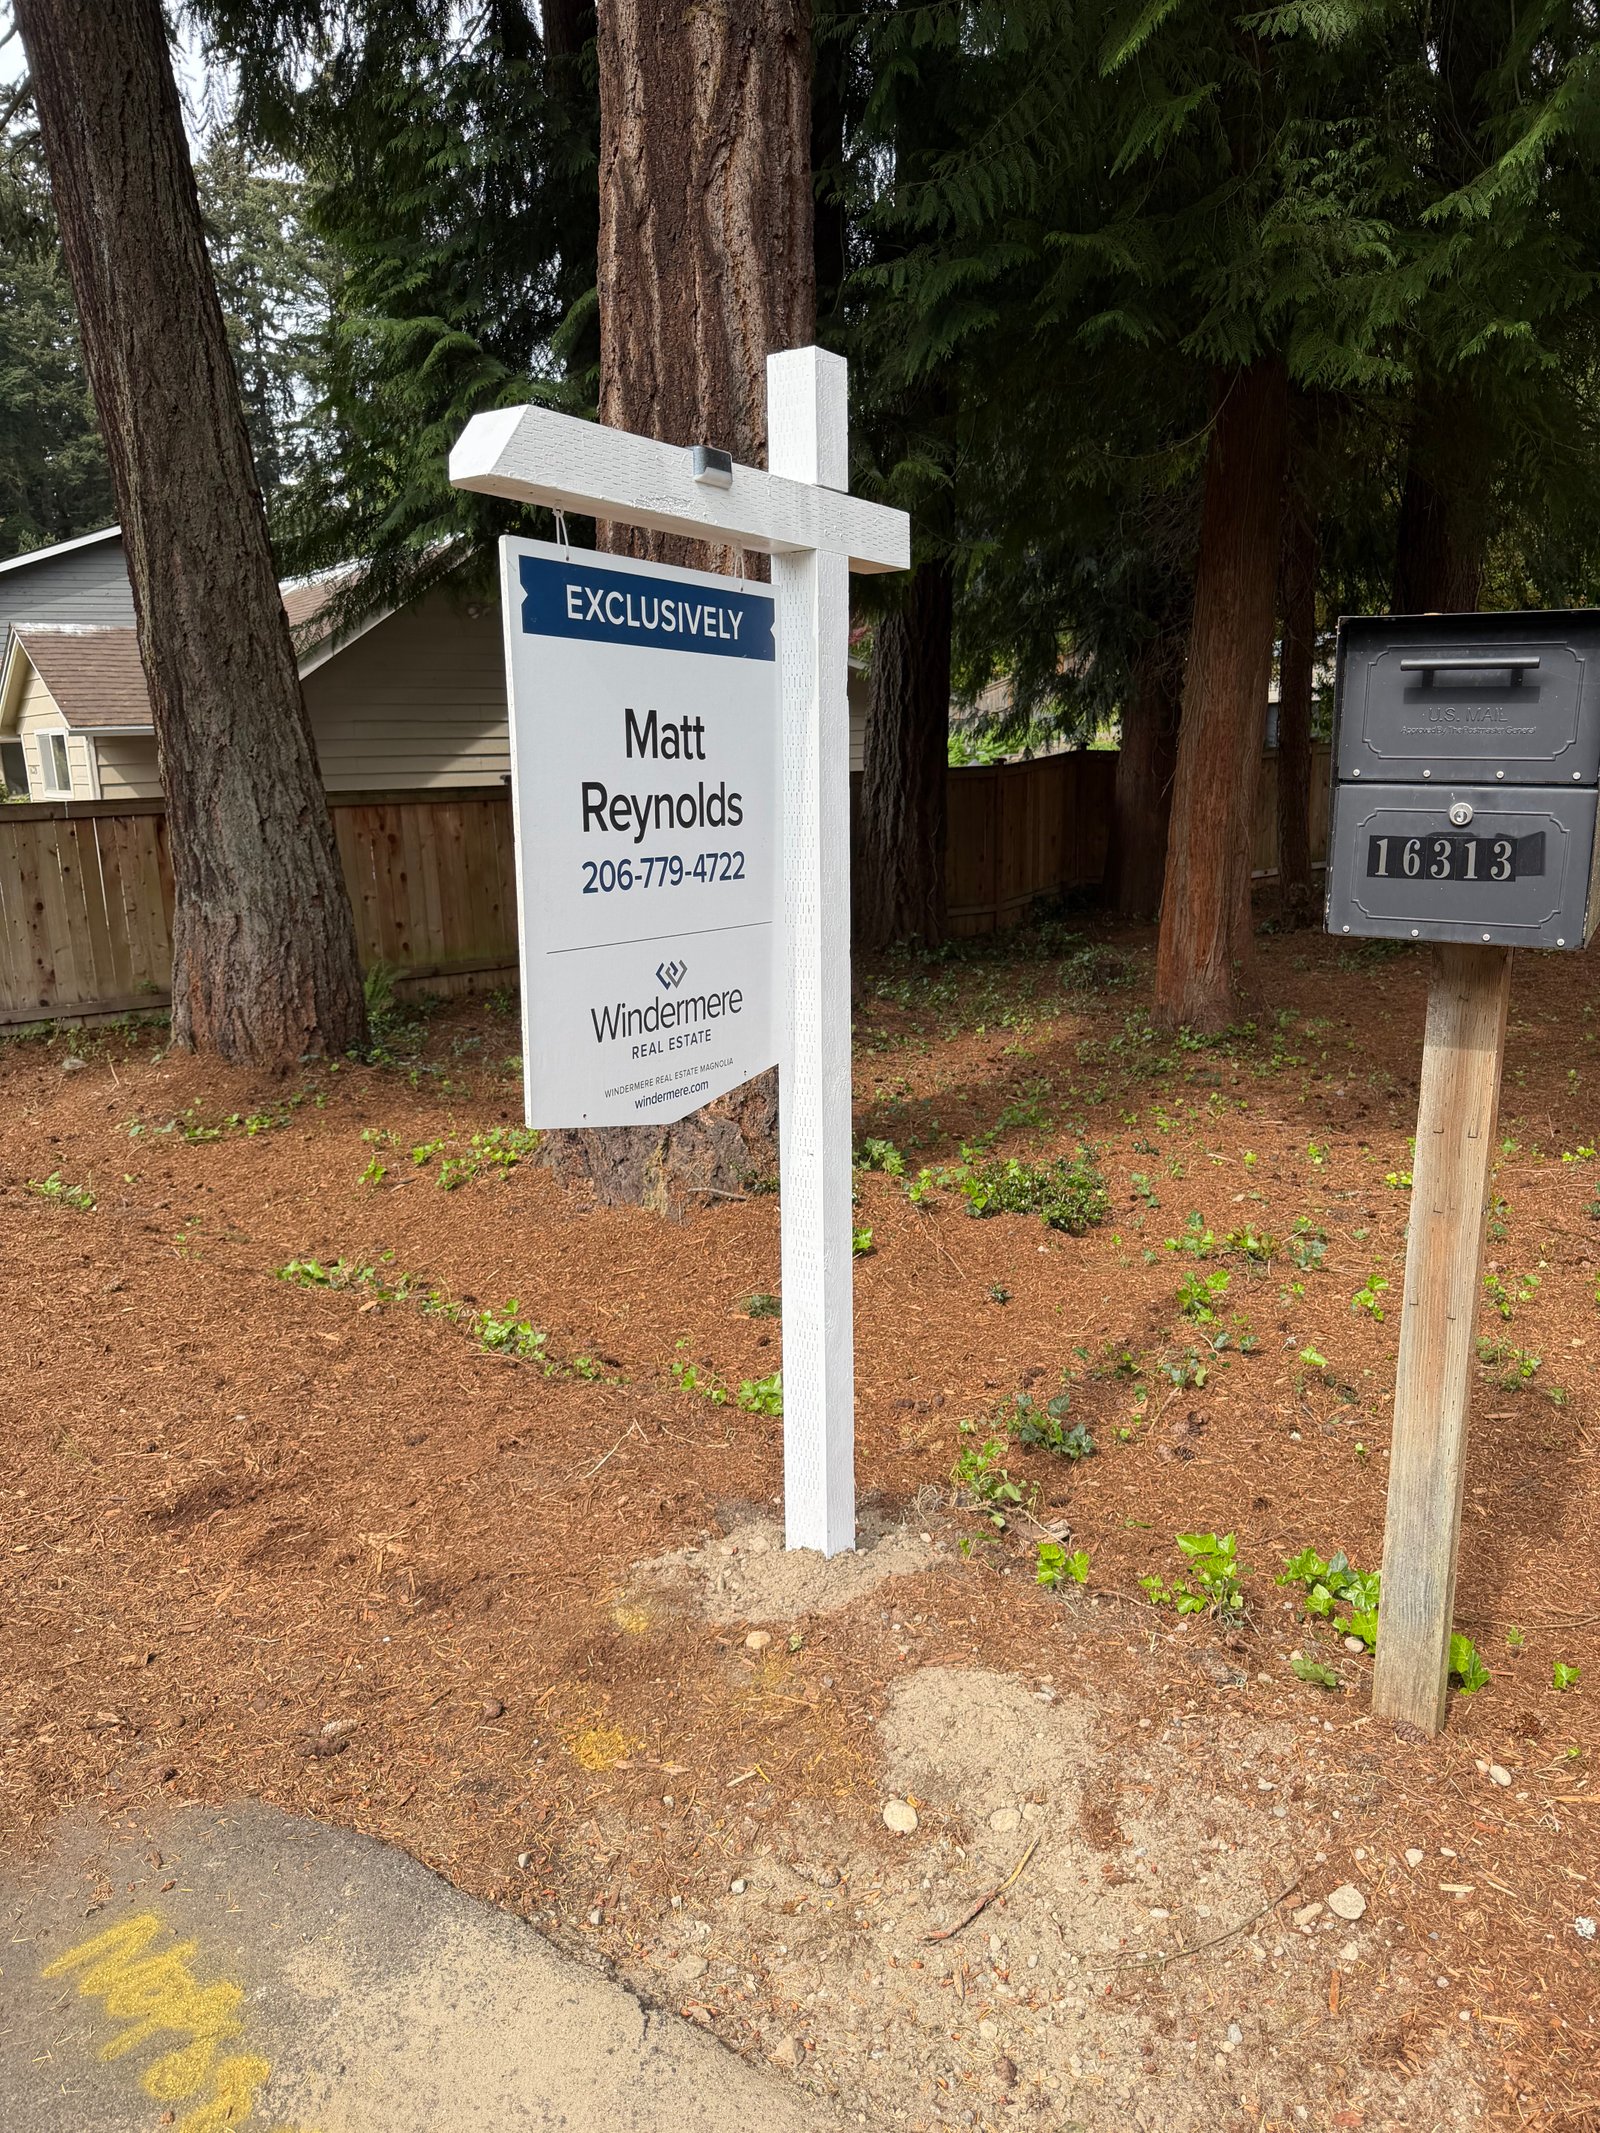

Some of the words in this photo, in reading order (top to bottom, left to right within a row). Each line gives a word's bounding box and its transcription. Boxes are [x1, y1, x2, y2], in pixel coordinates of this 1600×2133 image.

[566, 584, 743, 640] EXCLUSIVELY
[624, 708, 706, 761] Matt
[1401, 725, 1436, 736] Approved
[1447, 726, 1462, 735] The
[1462, 726, 1504, 735] Postmaster
[1505, 726, 1537, 736] General
[1428, 707, 1460, 722] U.S.
[1465, 707, 1508, 723] MAIL
[581, 781, 744, 844] Reynolds
[581, 850, 746, 894] 206-779-4722
[1373, 837, 1513, 881] 16313
[590, 988, 743, 1043] Windermere
[631, 1040, 664, 1060] REAL
[668, 1028, 712, 1051] ESTATE
[604, 1078, 654, 1099] WINDERMERE
[655, 1073, 673, 1085] REAL
[674, 1065, 699, 1081] ESTATE
[699, 1057, 734, 1074] MAGNOLIA
[634, 1080, 709, 1110] windermere.com
